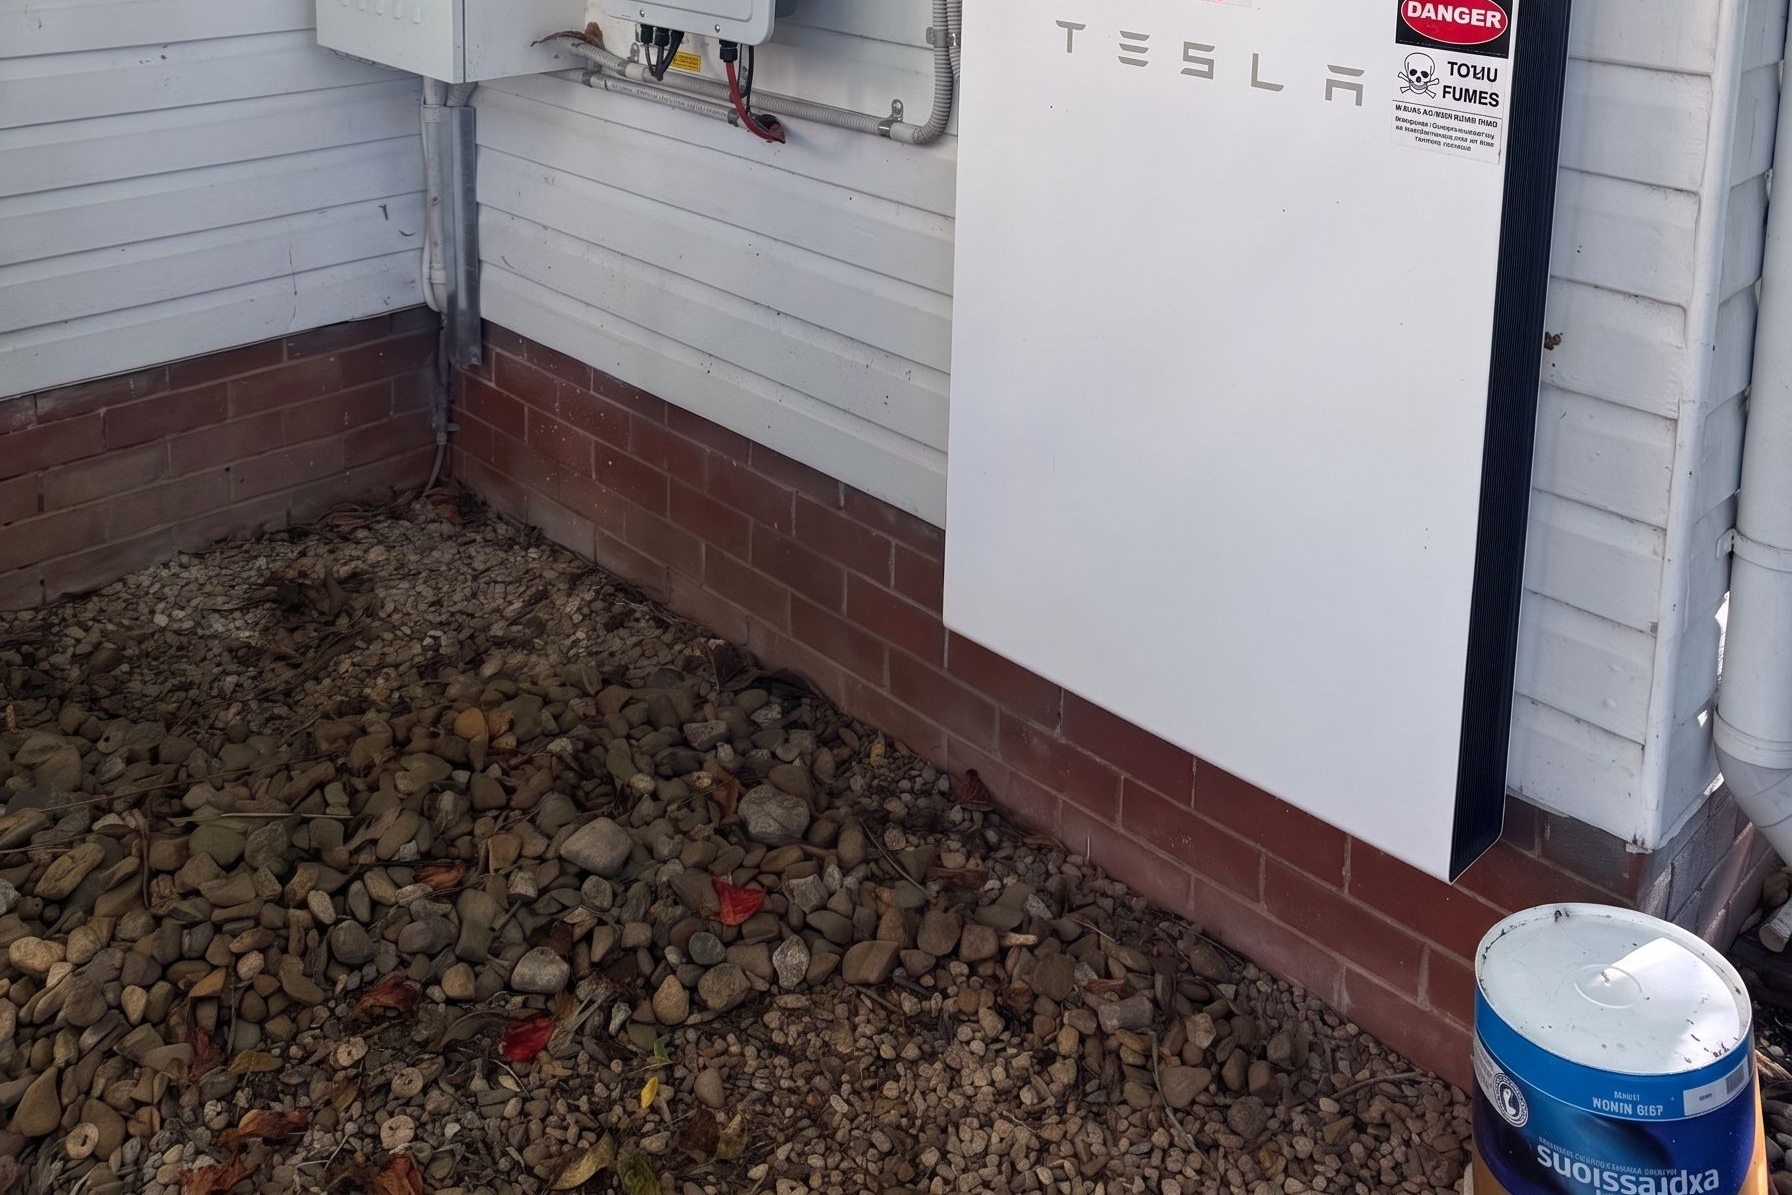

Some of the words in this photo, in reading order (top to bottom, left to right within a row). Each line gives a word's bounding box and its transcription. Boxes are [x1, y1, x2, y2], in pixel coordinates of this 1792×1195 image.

[1407, 0, 1502, 29] DANGER
[1055, 19, 1365, 107] TESLA
[1442, 85, 1500, 108] FUMES
